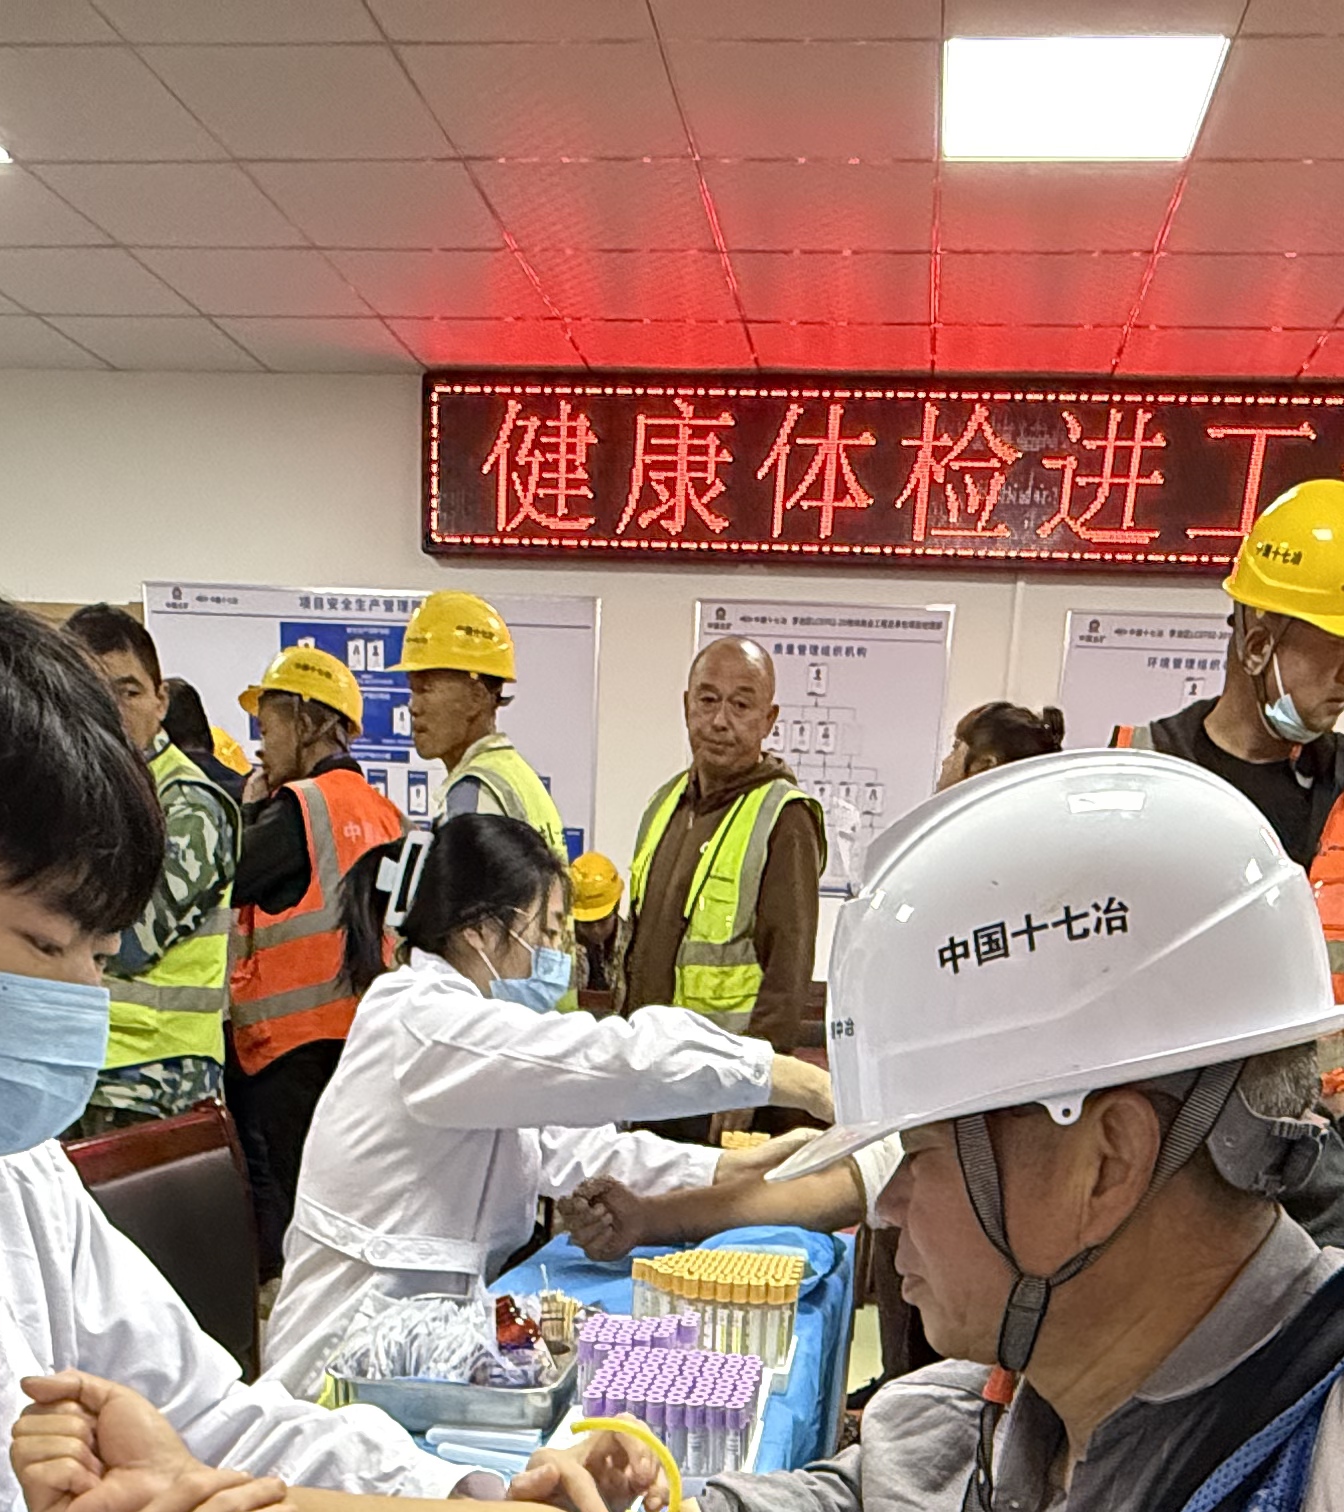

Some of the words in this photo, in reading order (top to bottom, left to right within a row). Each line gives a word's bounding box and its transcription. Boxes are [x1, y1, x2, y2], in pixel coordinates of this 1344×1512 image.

[1147, 656, 1227, 671] 环境管理组织
[937, 896, 1131, 974] 中国十七冶
